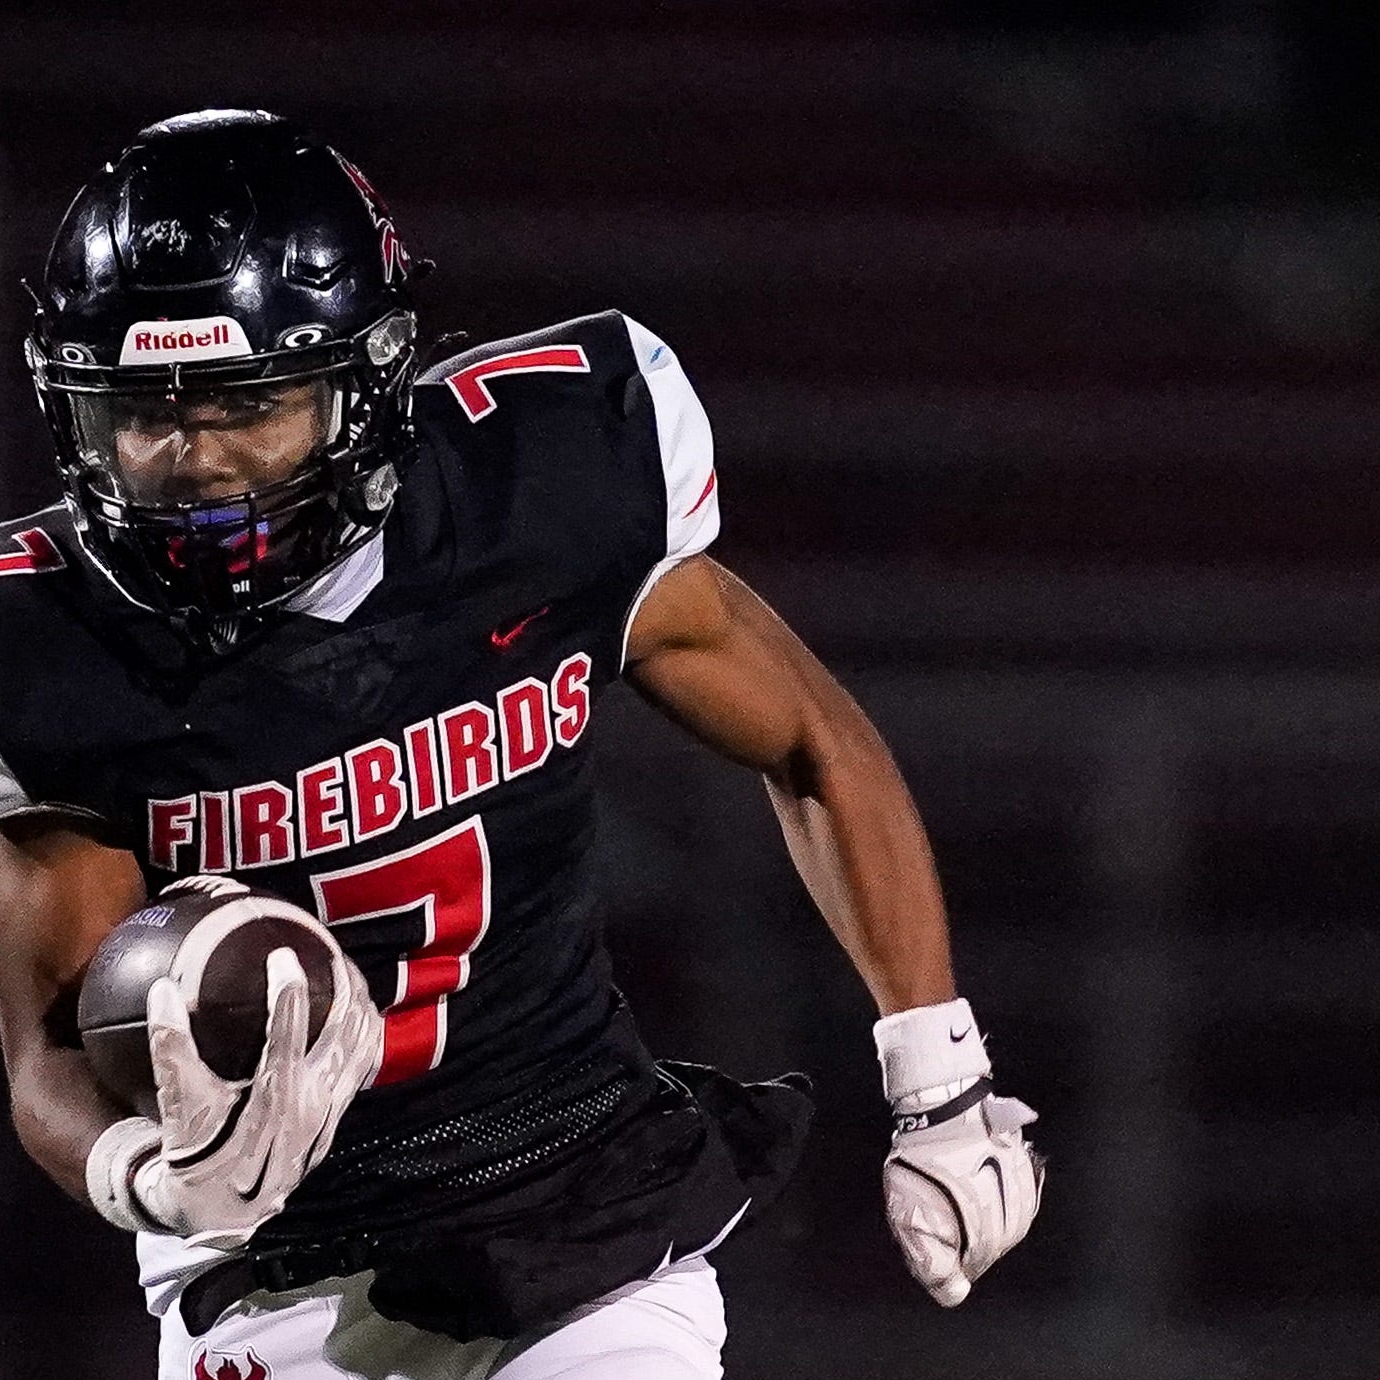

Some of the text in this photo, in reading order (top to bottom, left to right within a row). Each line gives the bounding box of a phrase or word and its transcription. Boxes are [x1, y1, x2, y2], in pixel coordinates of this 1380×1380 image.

[134, 324, 229, 351] Riddell
[446, 345, 590, 423] 7
[147, 651, 591, 873] FIREBIRDS
[310, 814, 491, 1089] 7
